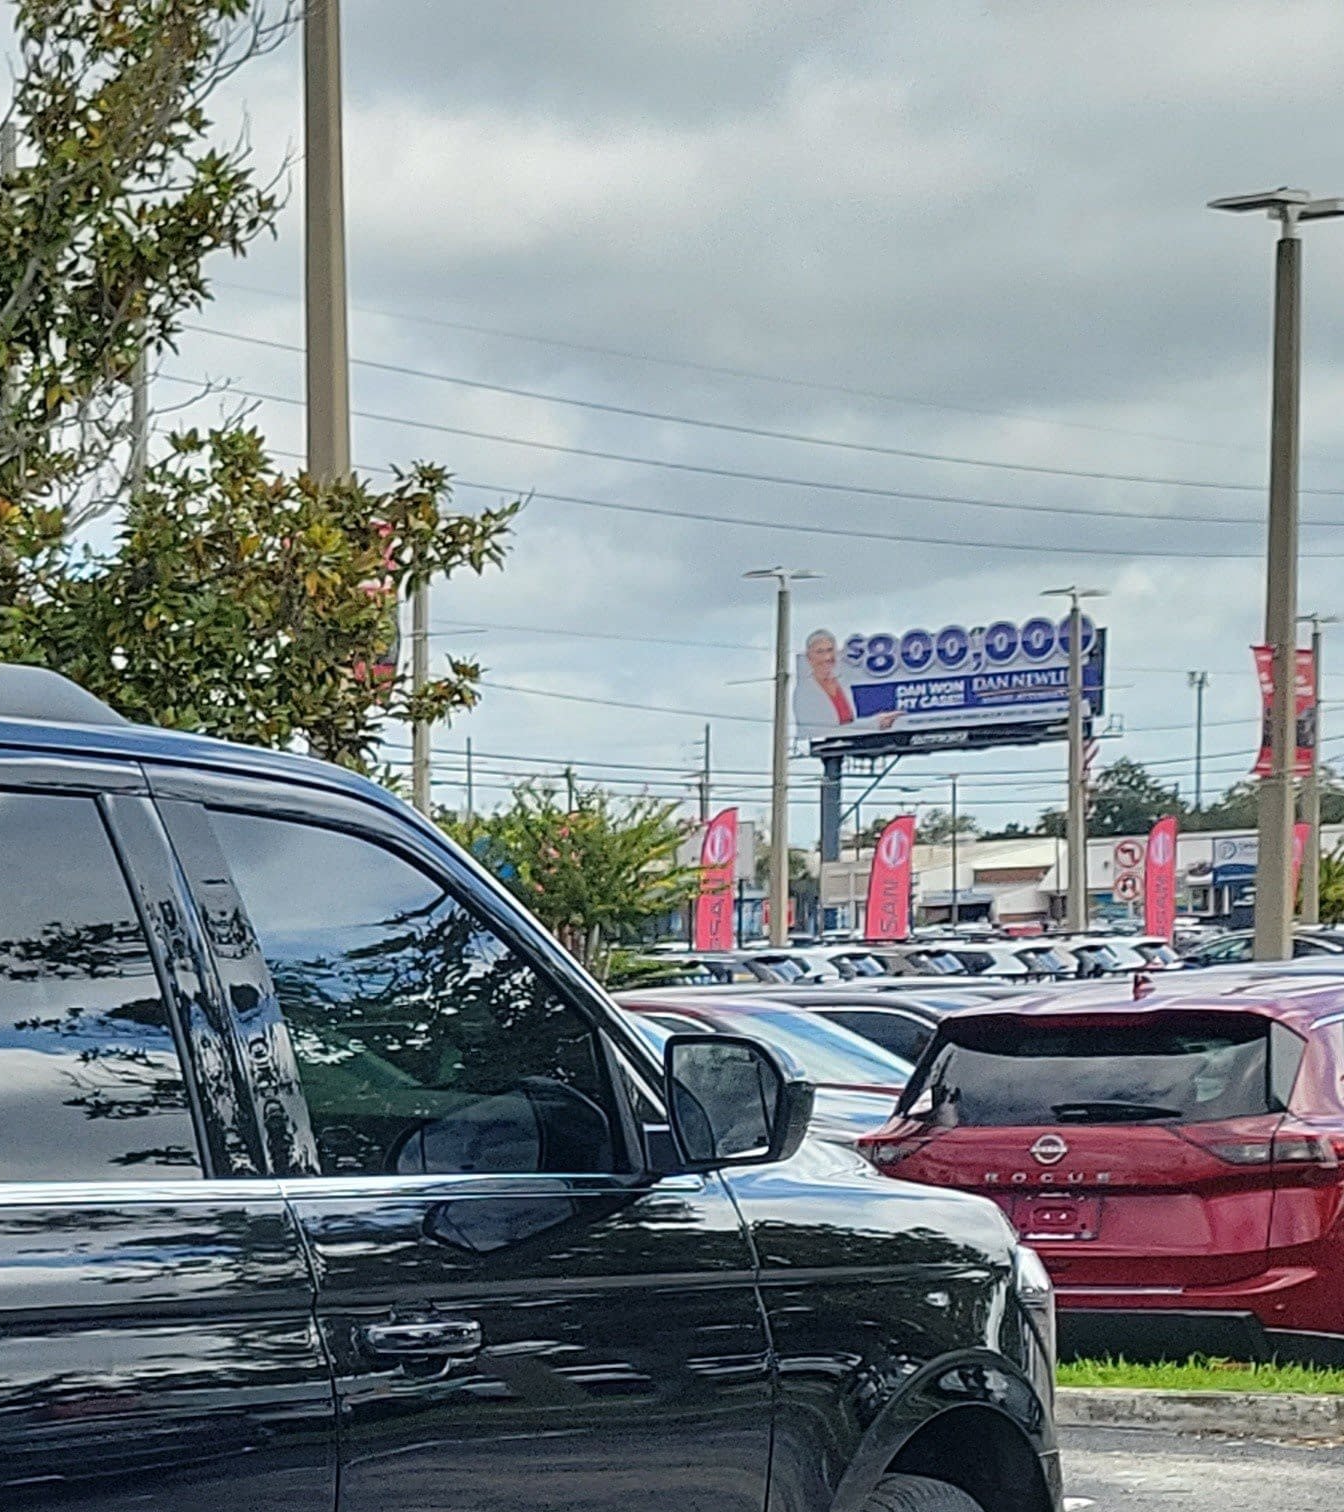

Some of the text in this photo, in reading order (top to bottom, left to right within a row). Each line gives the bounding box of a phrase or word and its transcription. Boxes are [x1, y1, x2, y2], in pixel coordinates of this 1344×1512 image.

[845, 614, 1095, 675] $800,000
[896, 680, 965, 698] DAN WON
[972, 669, 1069, 691] DAN NEWLI
